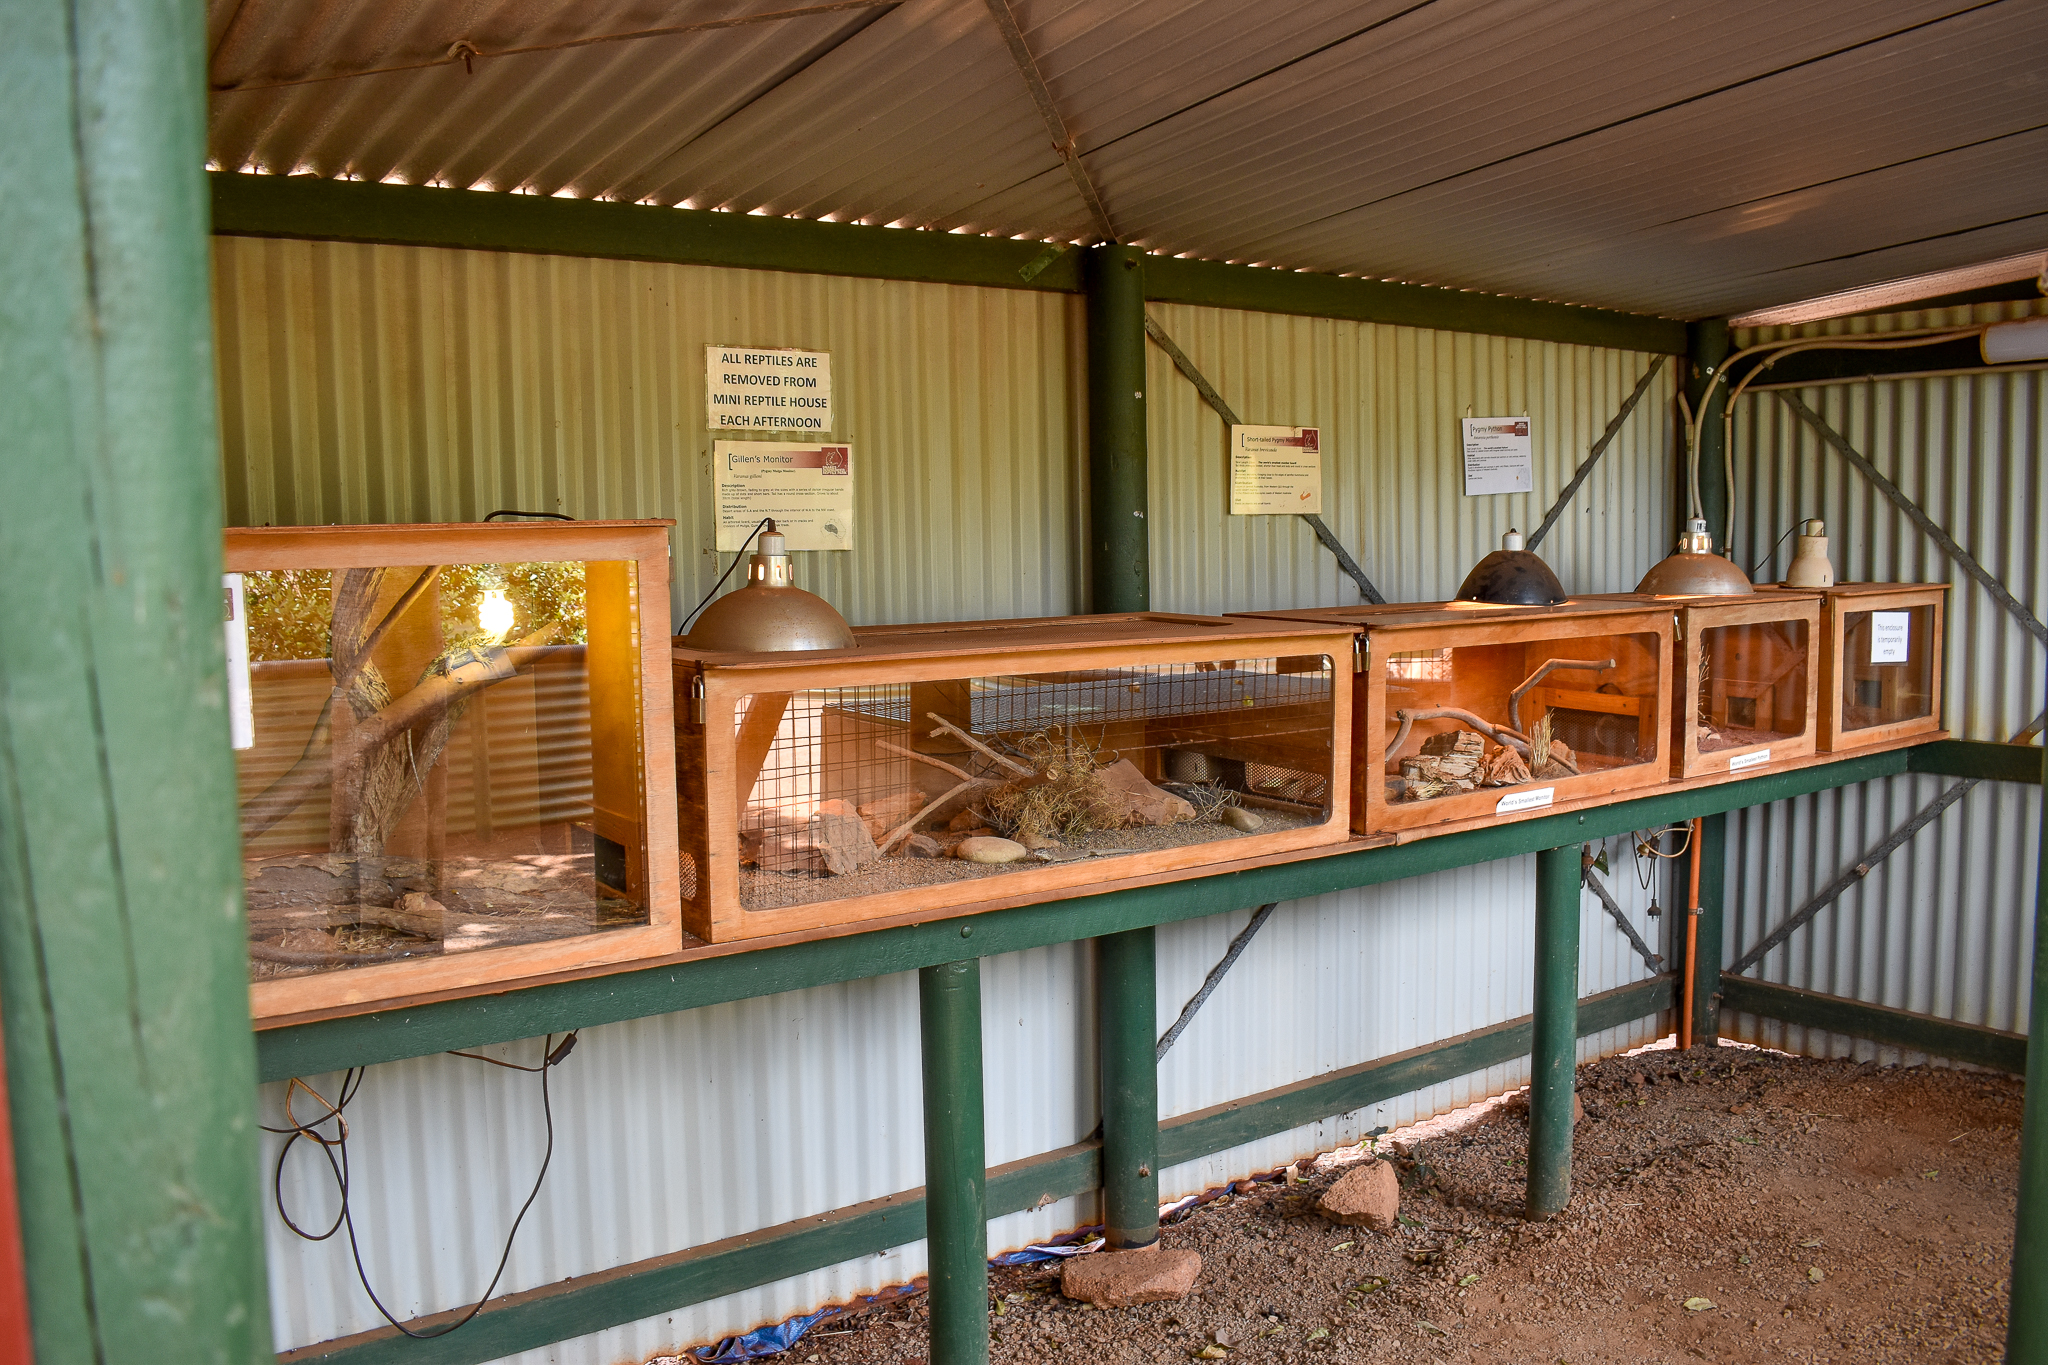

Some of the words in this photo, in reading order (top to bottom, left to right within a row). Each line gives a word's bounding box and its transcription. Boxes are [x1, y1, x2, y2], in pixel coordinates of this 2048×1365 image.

[722, 353, 741, 364] ALL
[744, 354, 793, 366] REPTILES
[796, 357, 817, 368] ARE
[724, 374, 780, 386] REMOVED
[784, 376, 816, 388] FROM
[713, 394, 740, 405] MINI
[744, 395, 786, 406] REPTILE
[790, 397, 827, 408] HOUSE
[720, 415, 750, 426] EACH
[753, 416, 821, 428] AFTERNOON
[763, 455, 793, 463] Monitor
